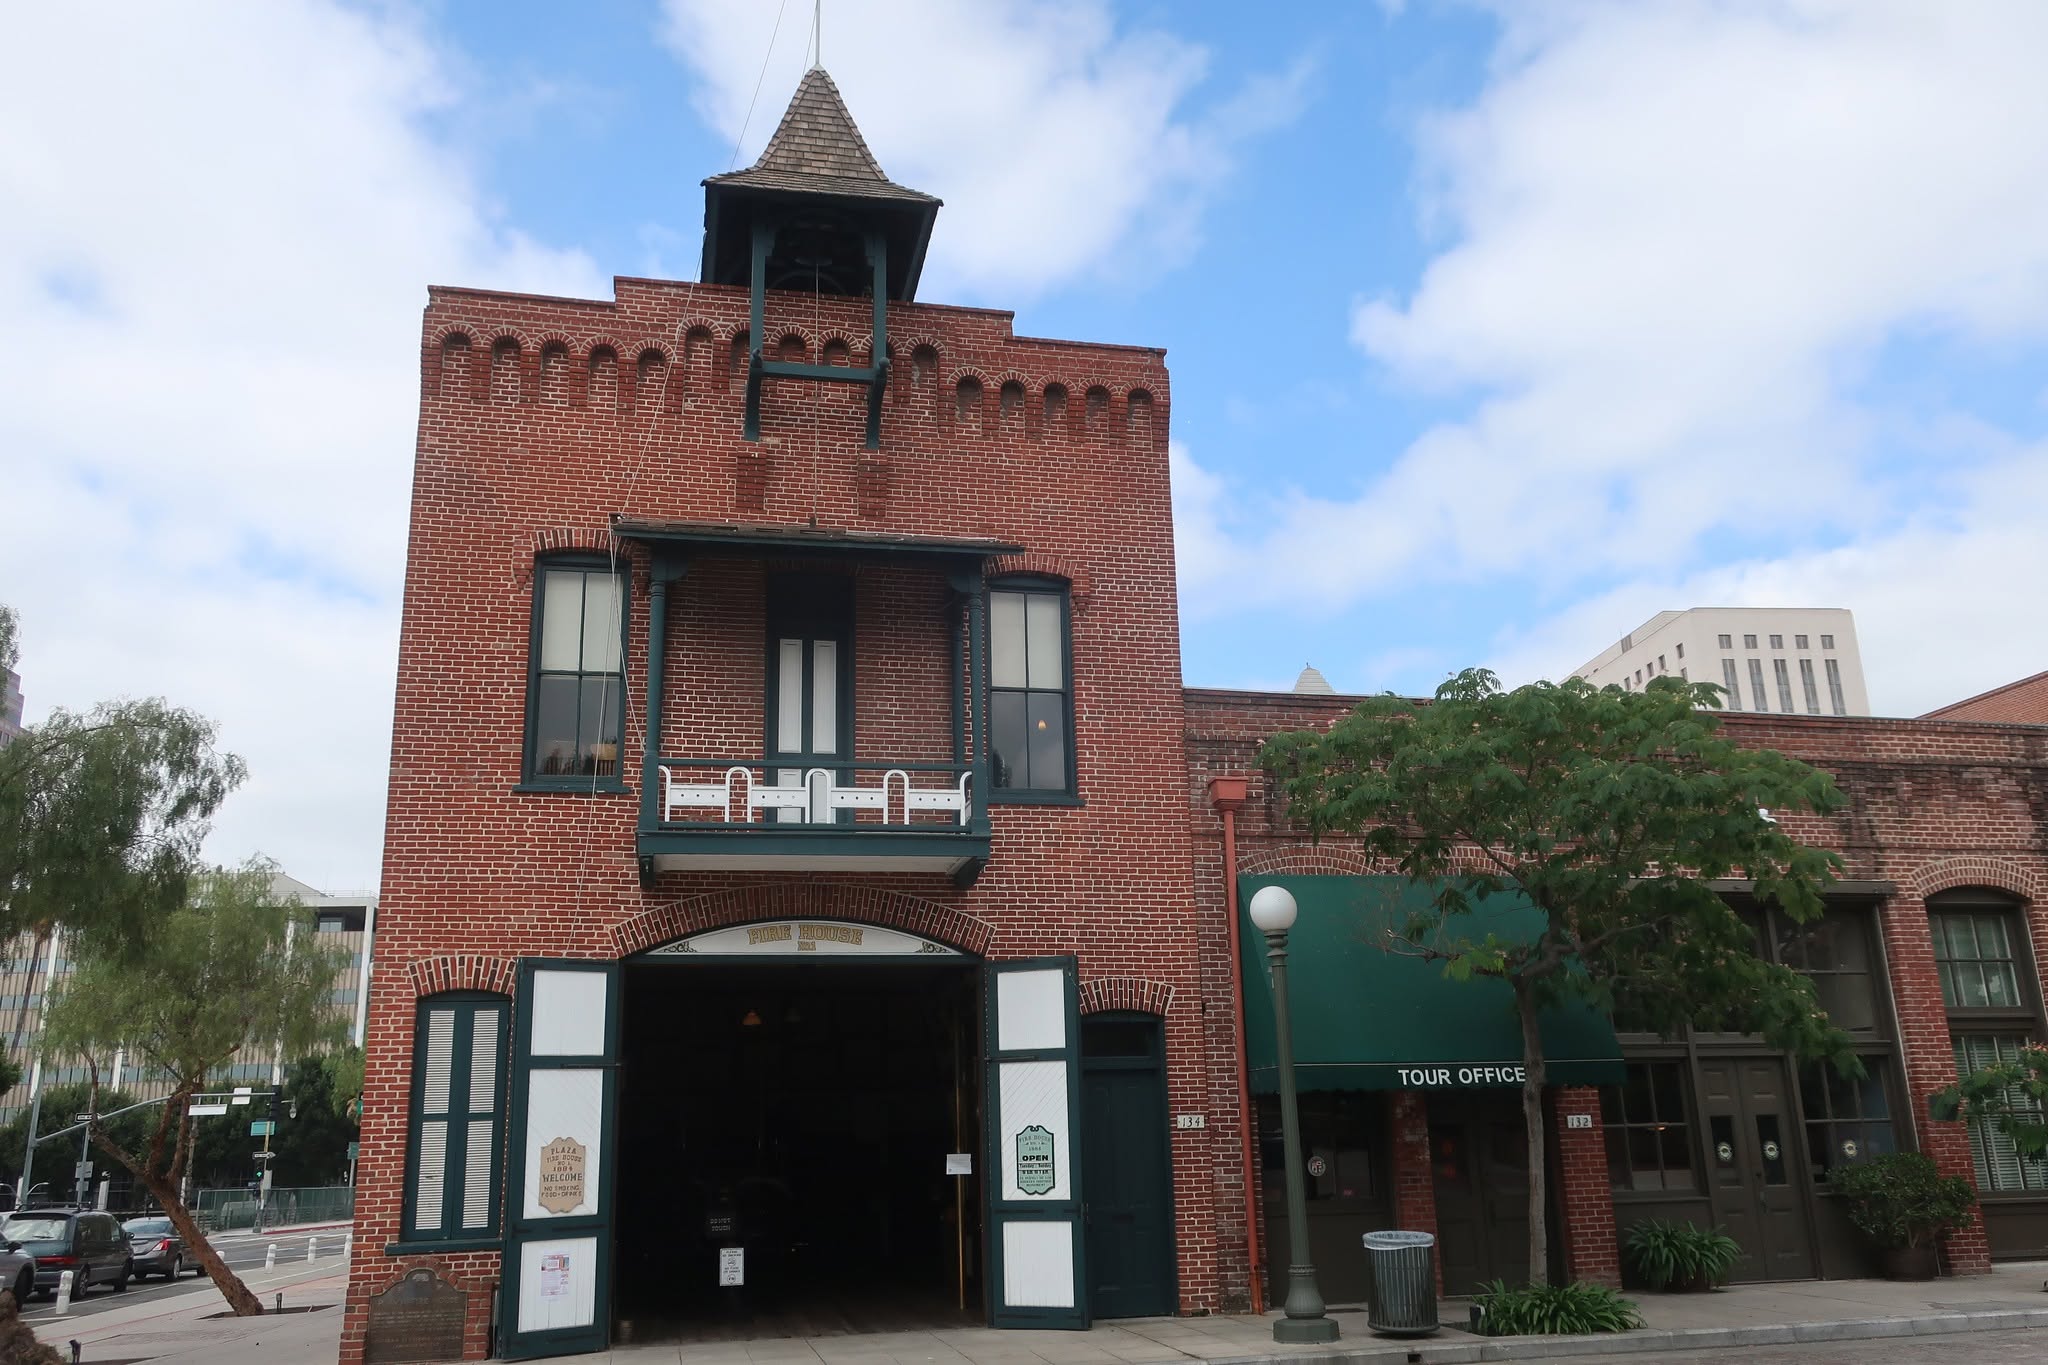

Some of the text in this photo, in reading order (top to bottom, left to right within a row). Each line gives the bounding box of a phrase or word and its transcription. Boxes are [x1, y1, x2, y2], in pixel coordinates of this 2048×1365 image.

[747, 924, 863, 945] FIRE HOUSE
[1398, 1067, 1526, 1086] TOUR OFFICE
[1182, 1116, 1200, 1127] 134
[1571, 1117, 1588, 1127] 132
[551, 1147, 576, 1155] PLAZA
[542, 1174, 583, 1182] WELCOME
